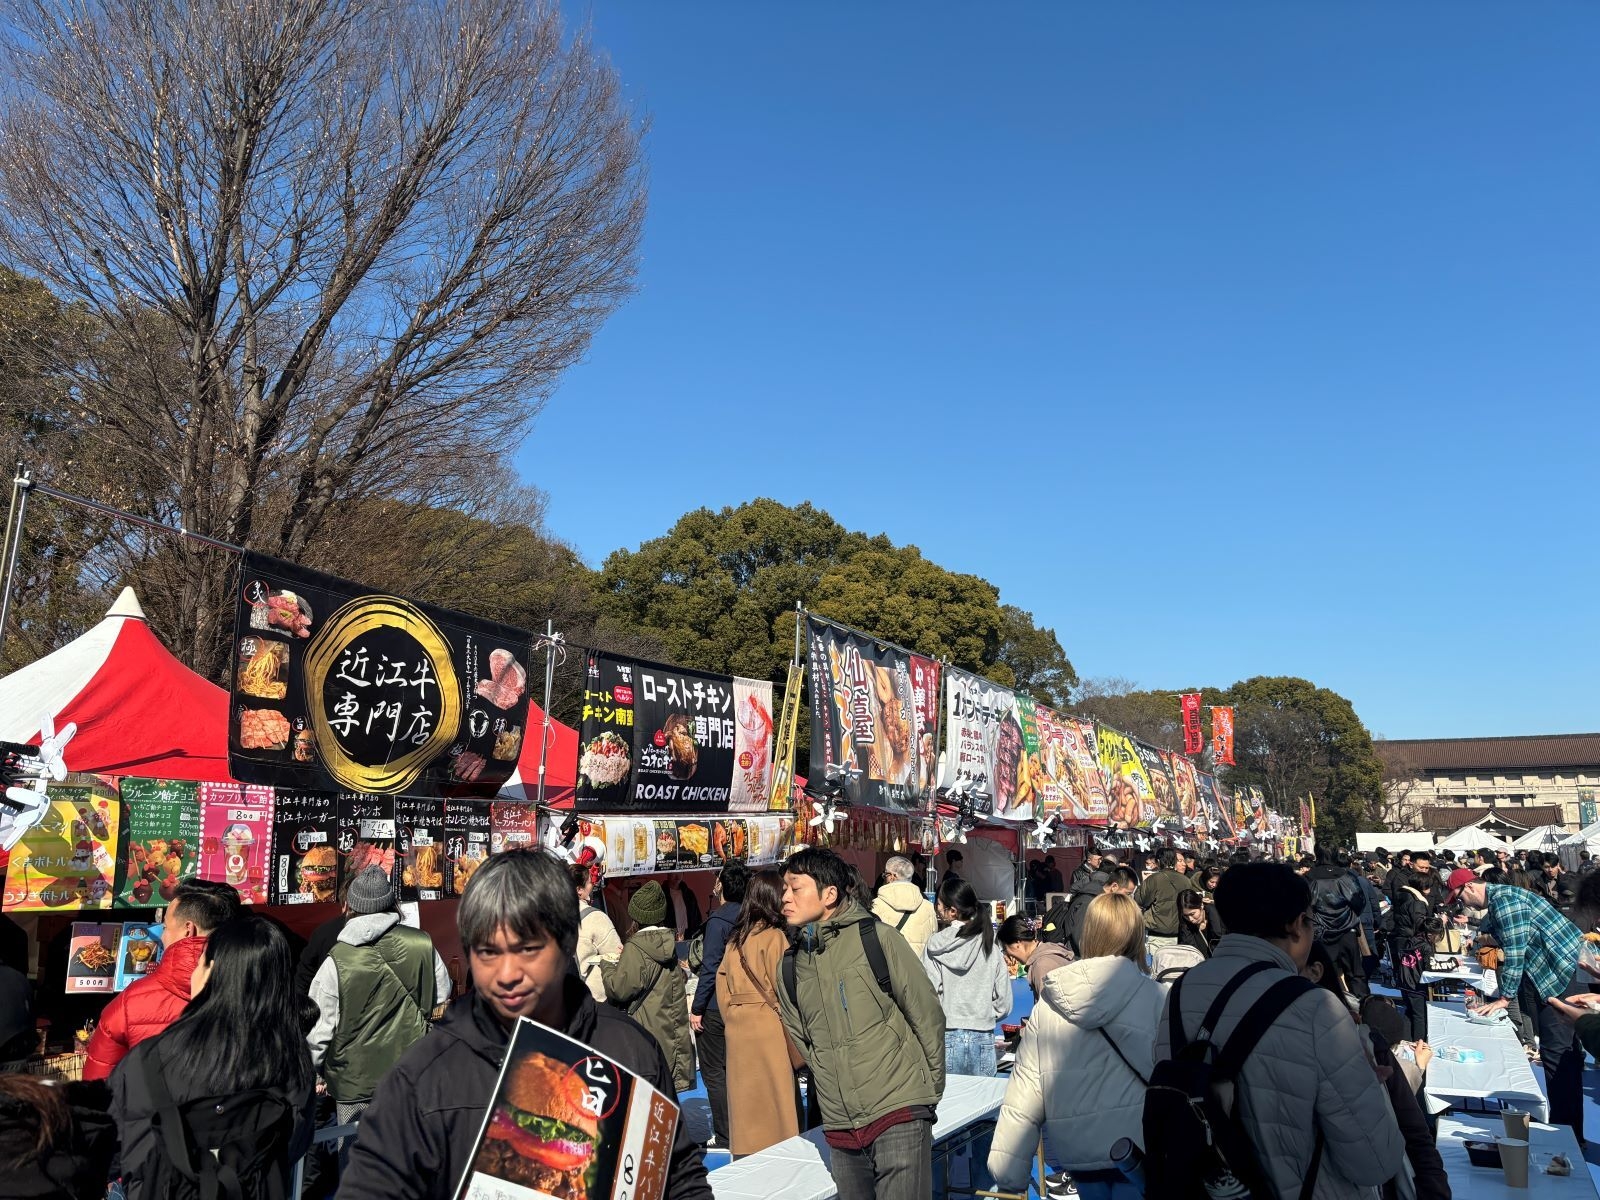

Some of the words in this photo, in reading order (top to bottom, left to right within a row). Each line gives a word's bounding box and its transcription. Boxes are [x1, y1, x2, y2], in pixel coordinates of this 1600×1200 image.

[241, 639, 257, 656] 極
[336, 645, 436, 699] 近江牛
[642, 674, 731, 714] ローストチキン
[328, 692, 434, 745] 専門店
[695, 715, 734, 749] 専門店
[126, 789, 195, 801] フルーツ飴チョコ
[339, 793, 379, 801] 近江牛専門店の
[635, 784, 679, 800] ROAST
[682, 786, 728, 801] CHICKEN
[353, 805, 383, 817] ジャンボ
[395, 802, 436, 812] 近江牛専門店の
[395, 815, 443, 826] 近江牛焼きそば
[445, 814, 491, 827] ホルモン焼きそば
[503, 810, 522, 819] 近江牛
[339, 819, 361, 827] 近江牛
[370, 829, 393, 838] ステーキ
[338, 832, 354, 851] 極
[4, 892, 69, 902] うさぎボトル
